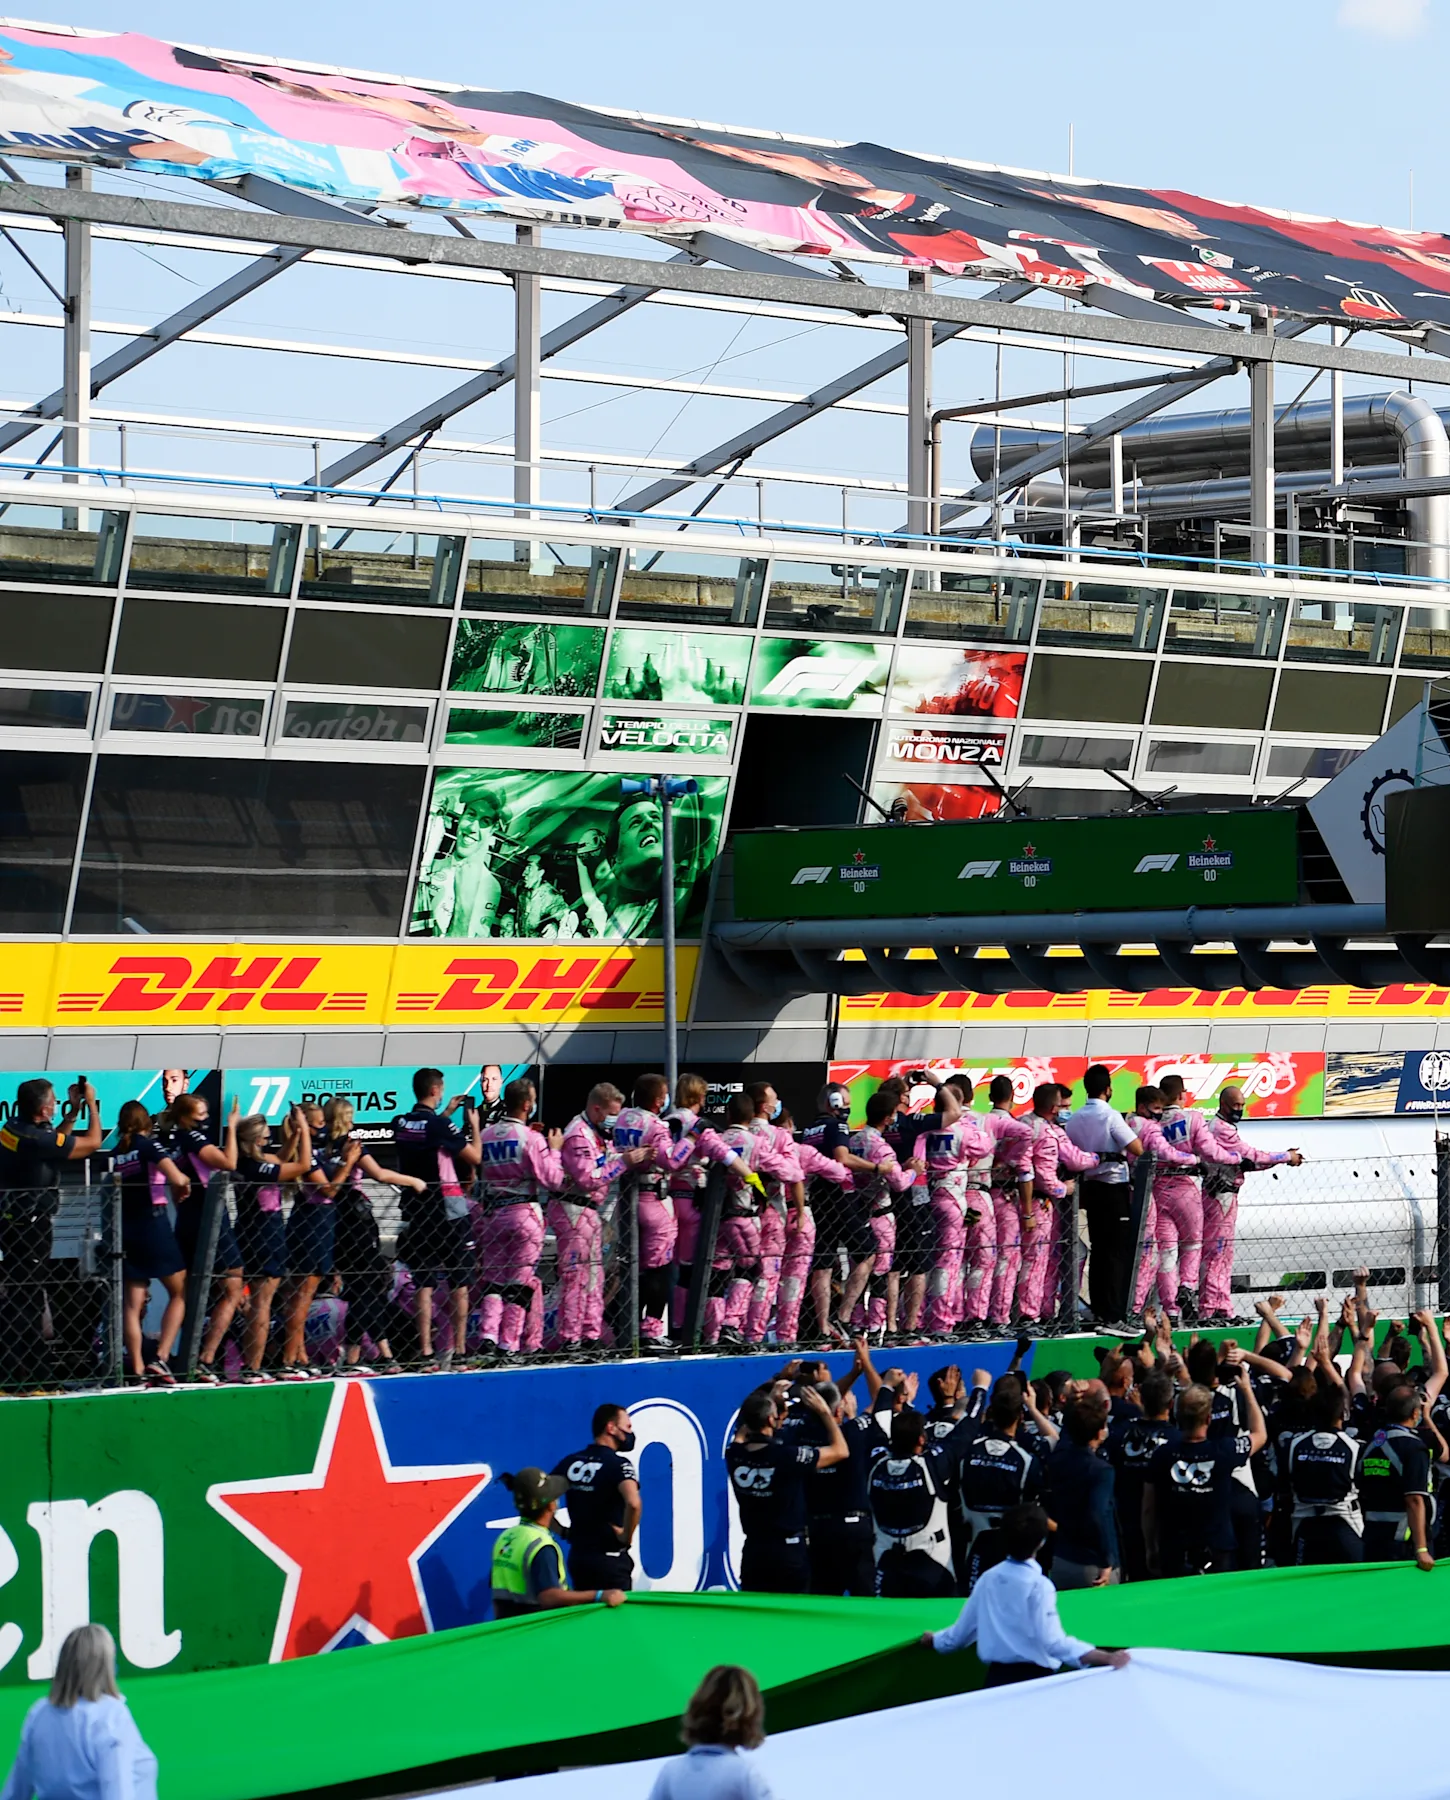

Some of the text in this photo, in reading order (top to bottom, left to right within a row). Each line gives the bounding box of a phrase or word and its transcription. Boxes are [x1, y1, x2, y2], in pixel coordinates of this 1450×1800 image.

[603, 720, 615, 729] IL
[616, 721, 666, 730] TEMPIO
[894, 734, 1004, 746] AUTODROMO NAZIONALE
[886, 742, 1001, 763] MONZA
[1009, 859, 1052, 875] Heineken
[1188, 853, 1232, 869] Heineken
[839, 865, 879, 880] Heineken
[100, 957, 642, 1011] DHL DHL
[302, 1079, 353, 1090] VALTTERI
[248, 1077, 290, 1117] 77
